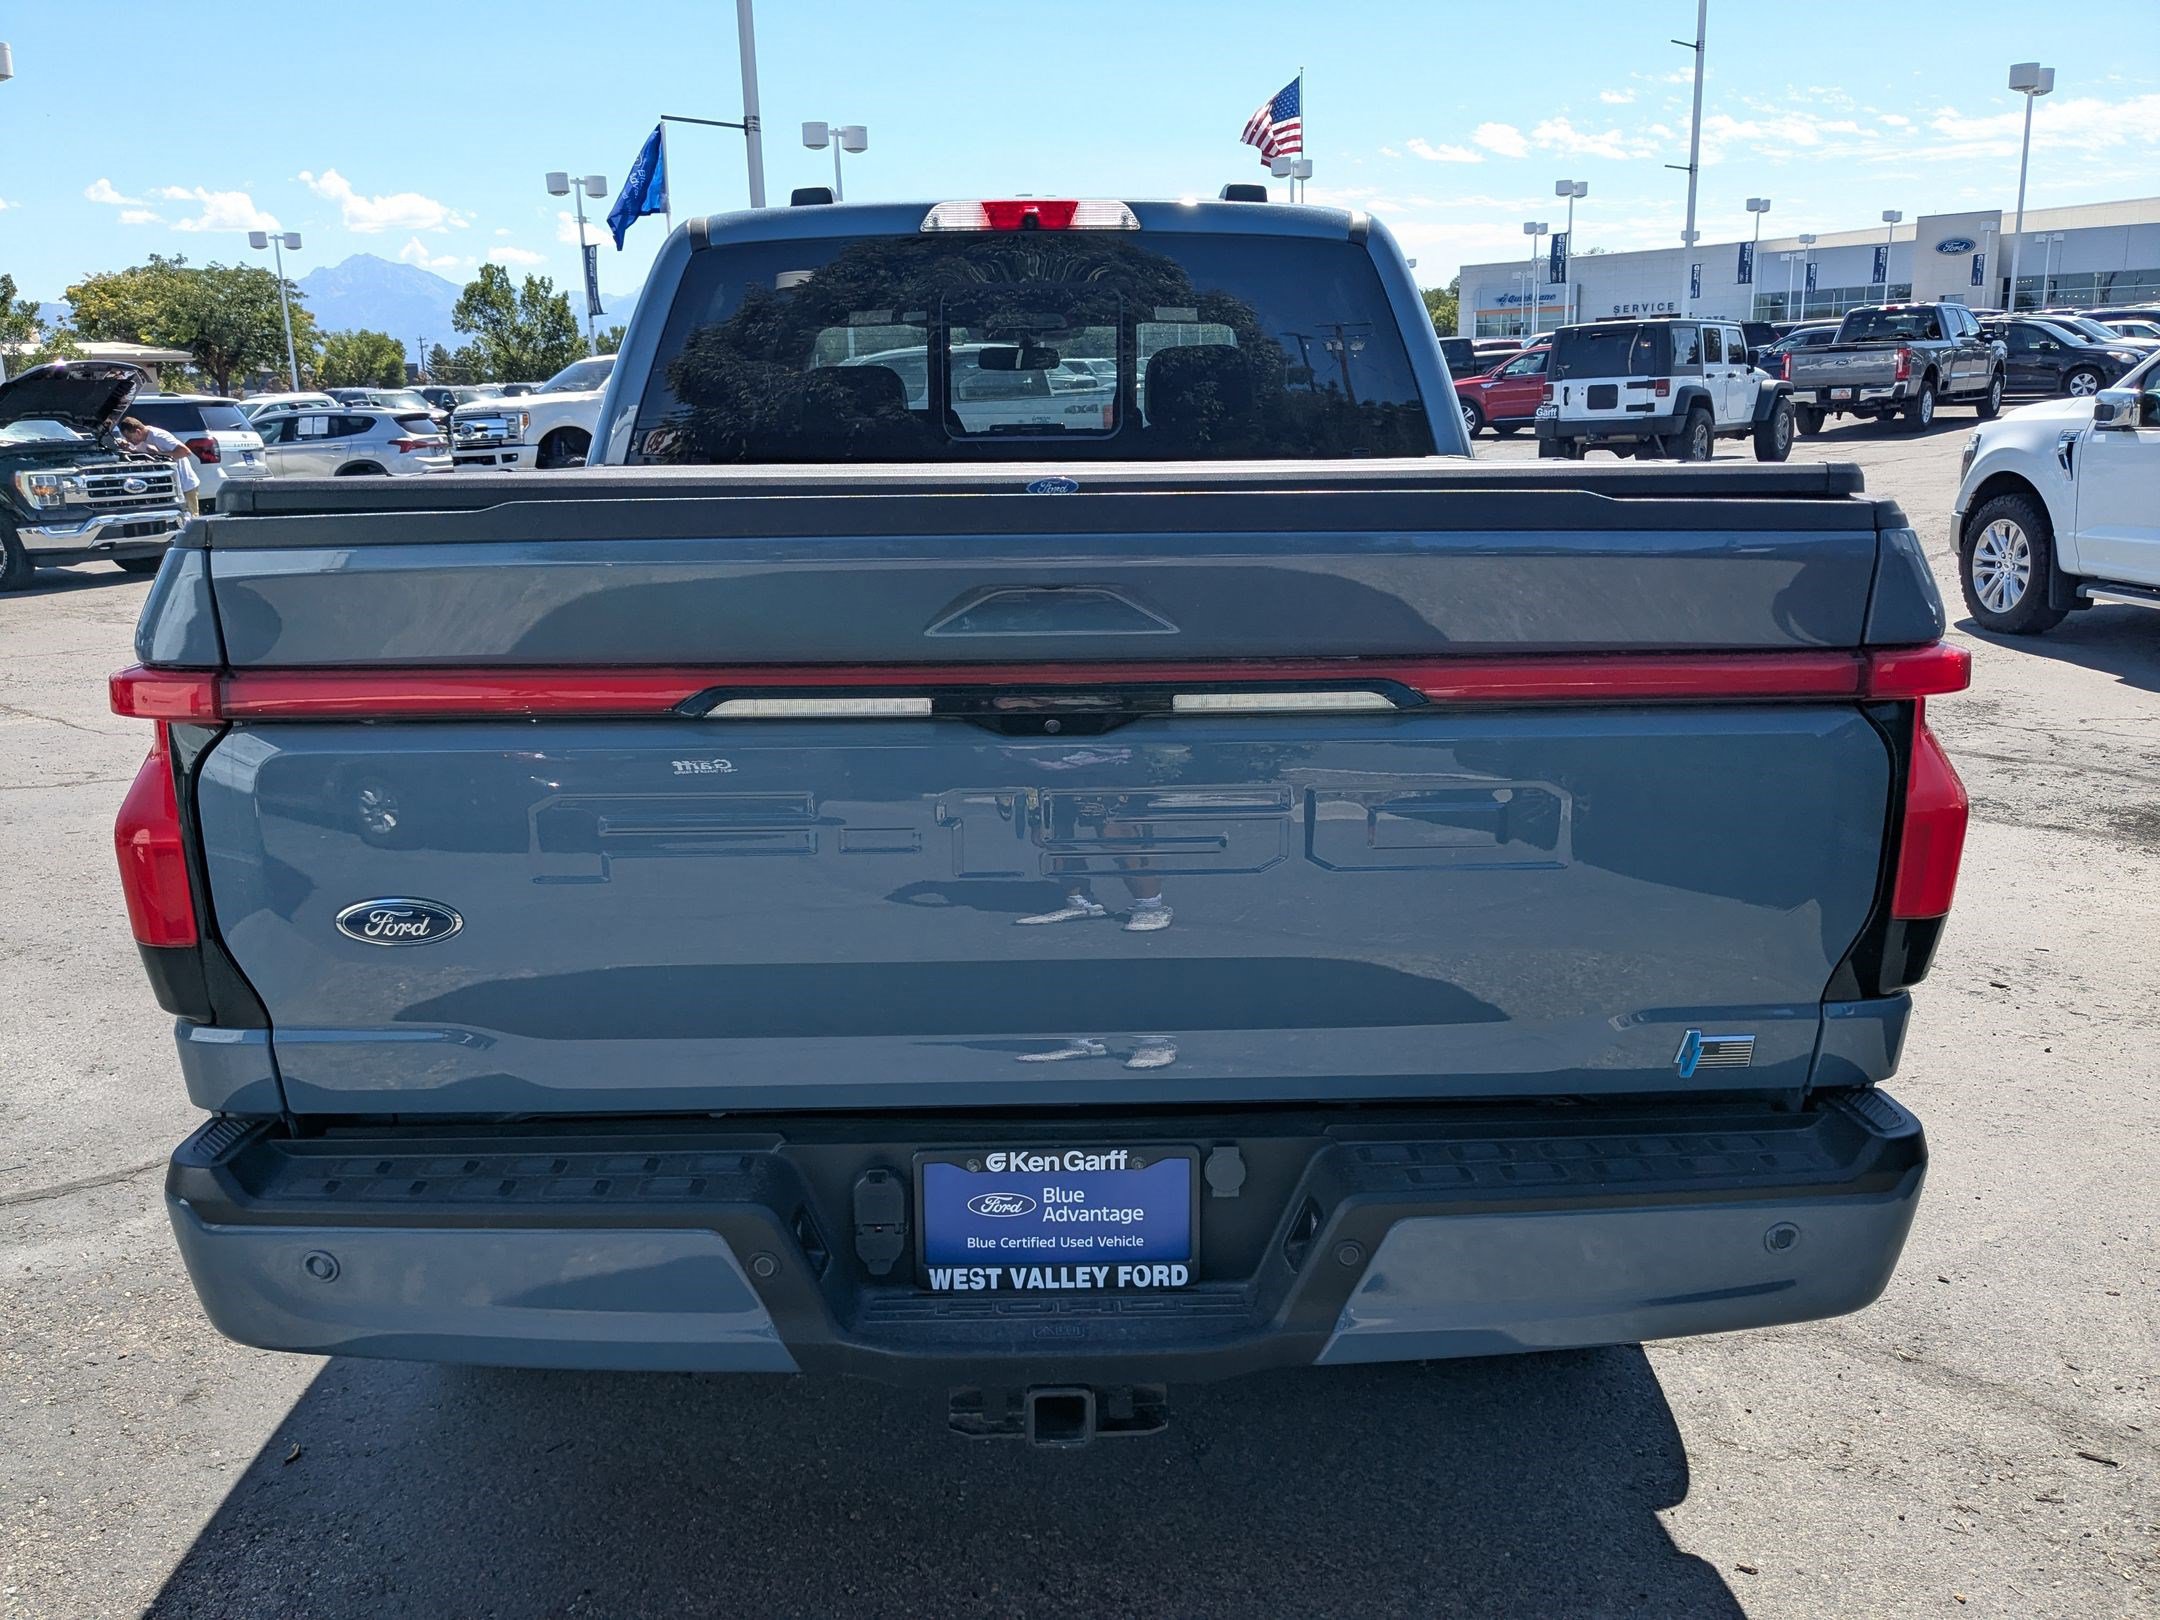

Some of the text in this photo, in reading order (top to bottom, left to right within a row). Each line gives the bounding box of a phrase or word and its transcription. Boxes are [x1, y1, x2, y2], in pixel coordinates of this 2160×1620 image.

[1613, 302, 1675, 314] SERVICE
[1536, 407, 1557, 417] Garff
[1037, 481, 1069, 495] Ford
[364, 909, 431, 936] Ford
[1009, 1150, 1128, 1172] Ken Garff
[1042, 1187, 1085, 1203] Blue
[980, 1196, 1023, 1214] Ford
[1042, 1206, 1144, 1224] Advantage
[966, 1235, 1144, 1249] Blue Certified Used Vehicle
[928, 1264, 1189, 1291] WEST VALLEY FORD
